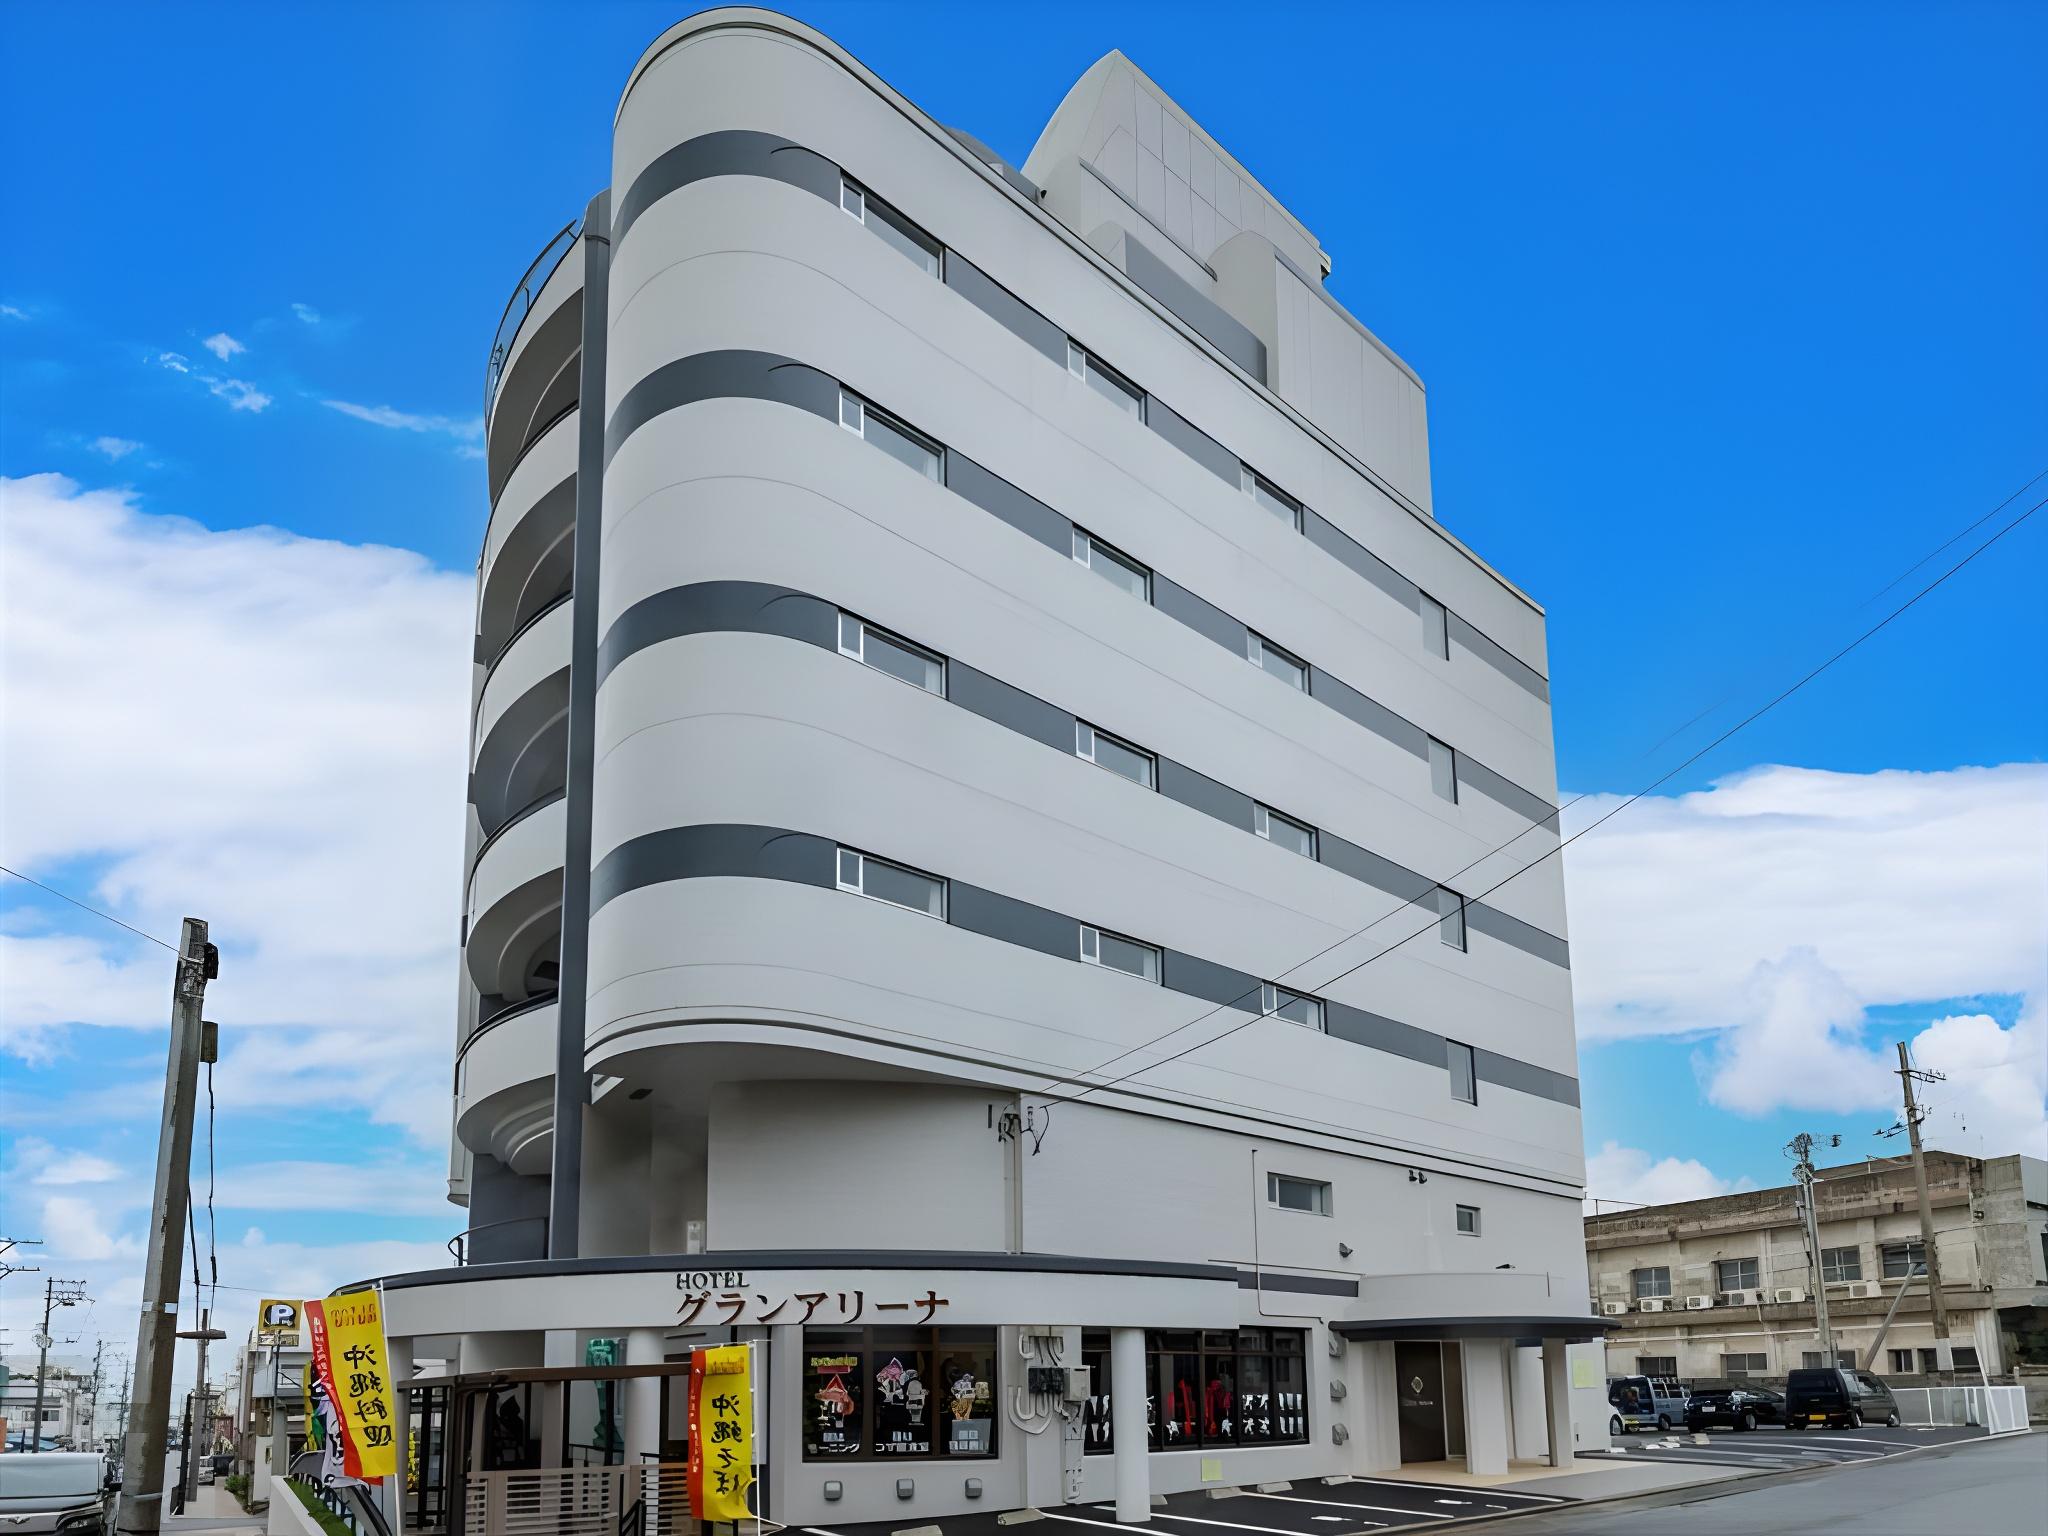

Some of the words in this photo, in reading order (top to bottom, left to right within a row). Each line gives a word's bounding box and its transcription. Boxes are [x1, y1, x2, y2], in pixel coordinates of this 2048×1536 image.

[676, 1271, 750, 1290] HOTEL
[271, 1304, 294, 1325] P
[676, 1290, 949, 1326] グランアリーナ
